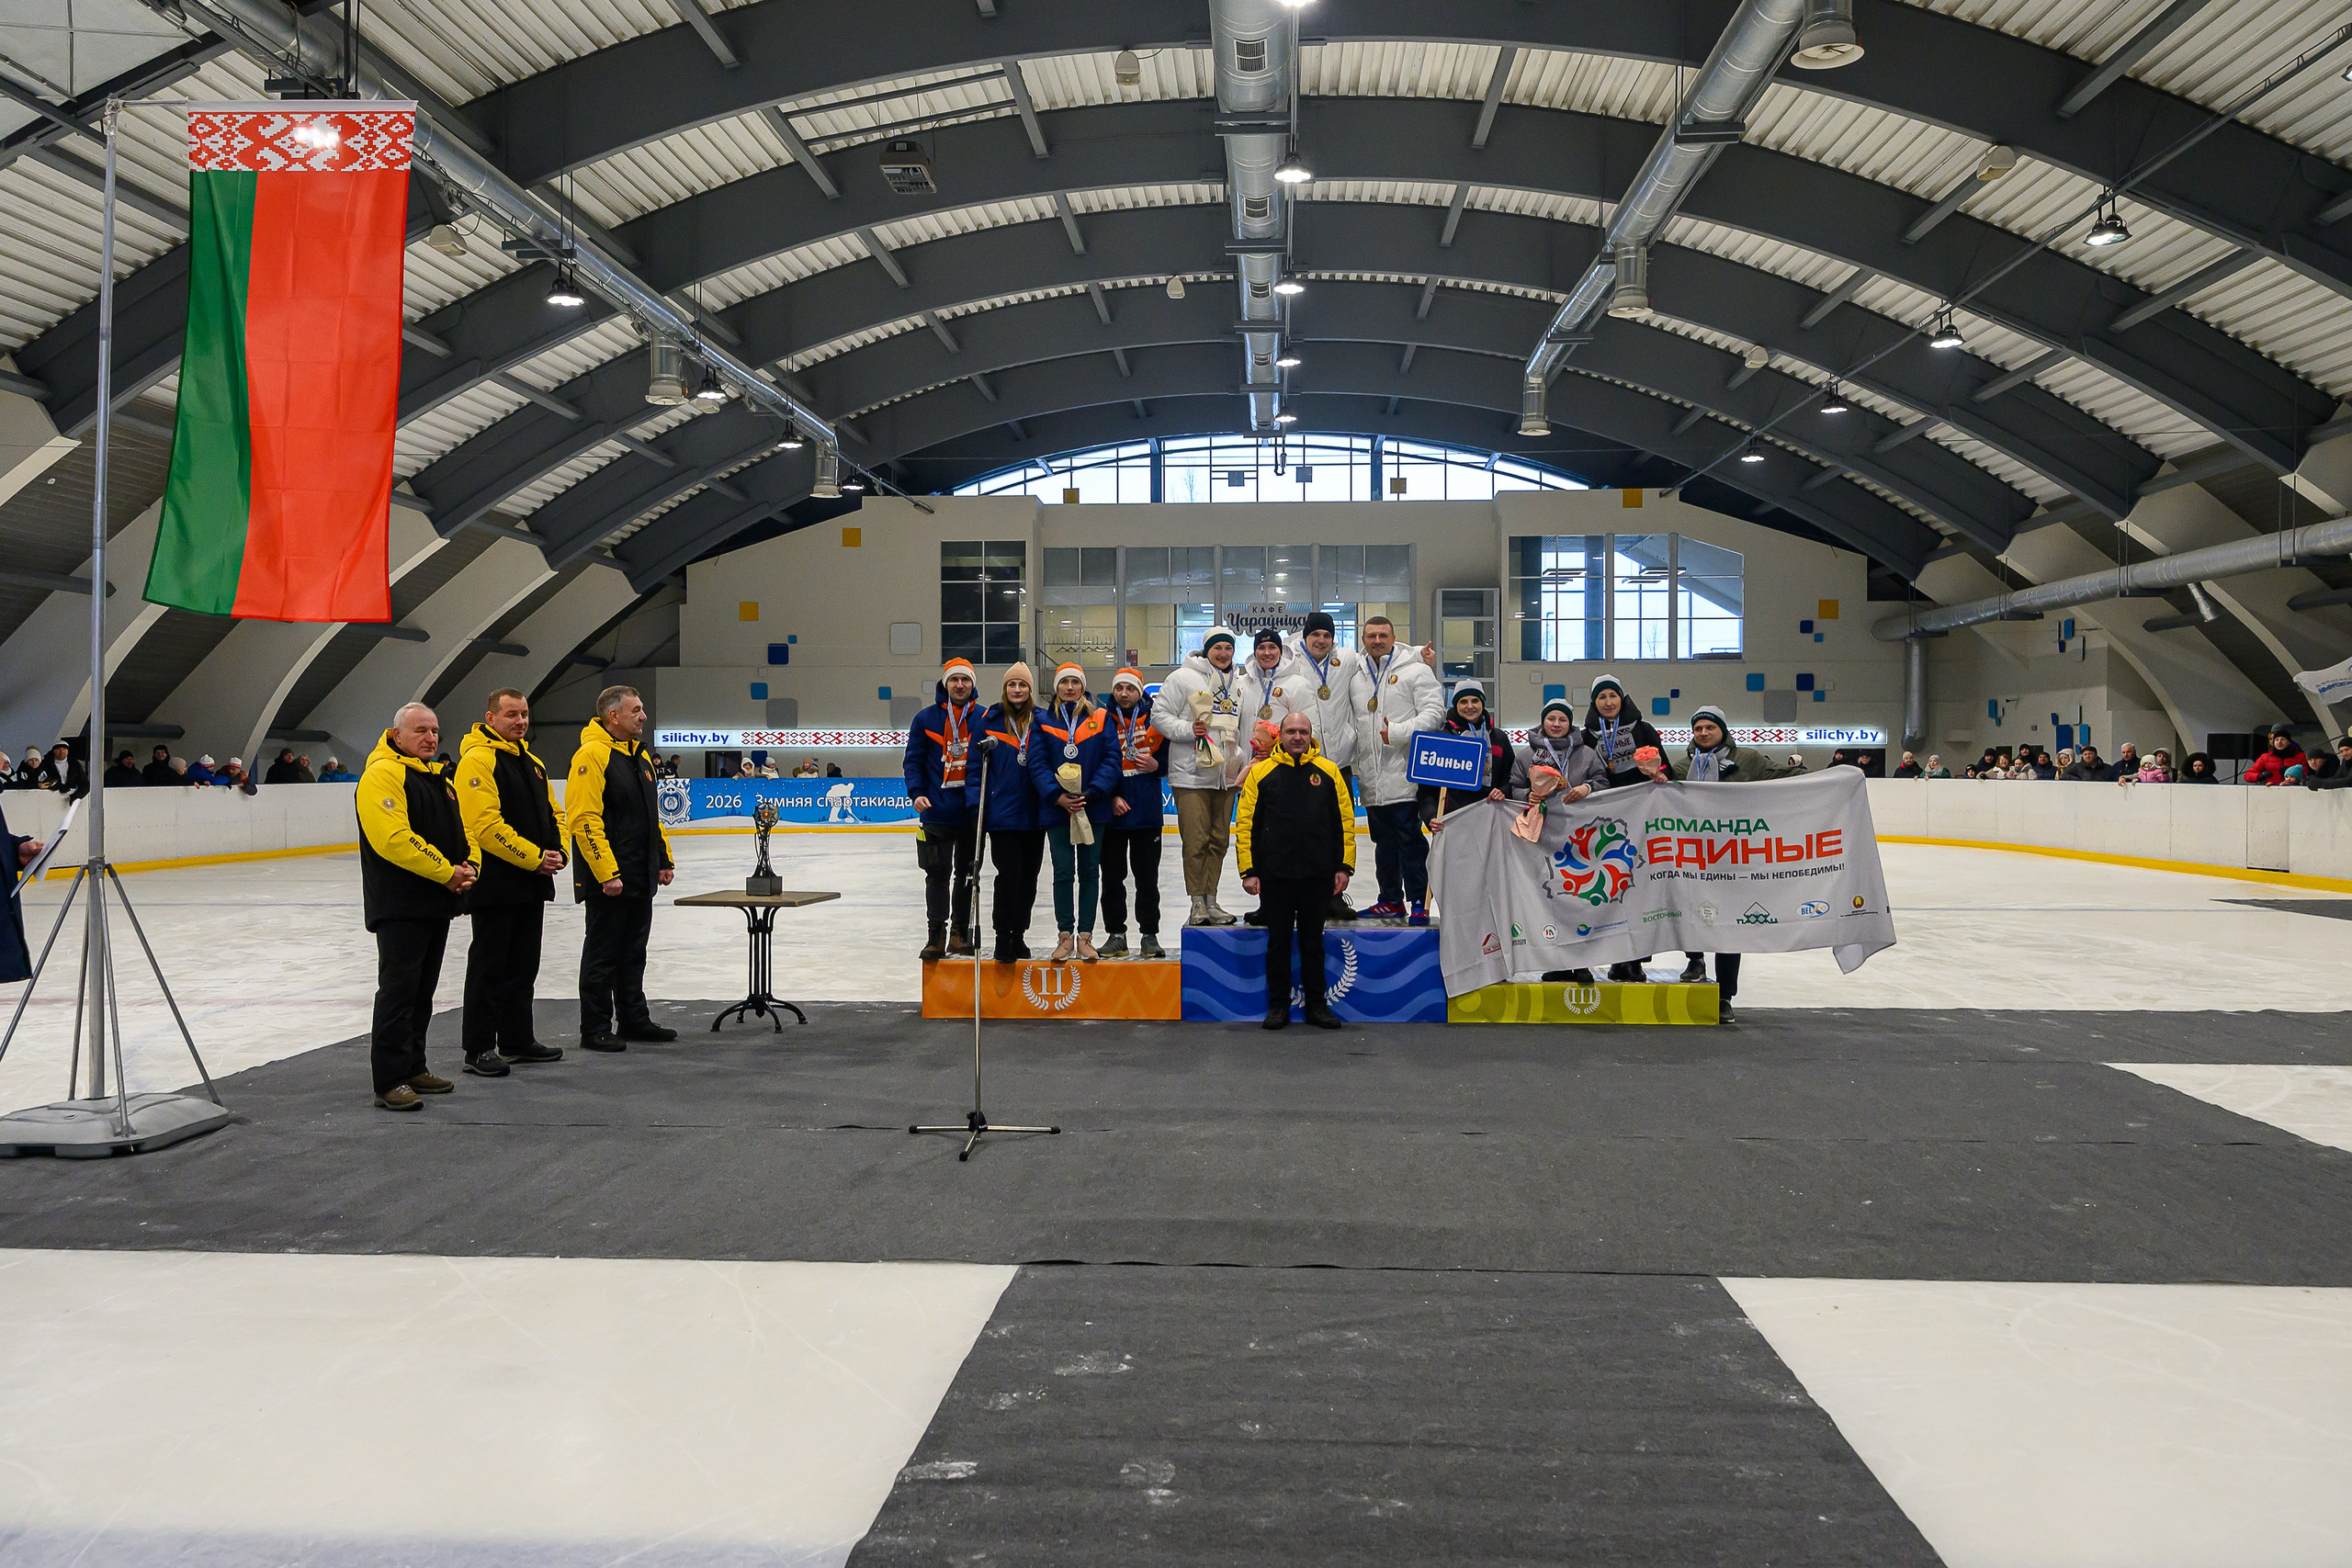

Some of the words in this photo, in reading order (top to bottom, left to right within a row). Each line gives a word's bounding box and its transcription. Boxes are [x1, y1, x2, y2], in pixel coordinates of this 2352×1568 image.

[662, 732, 729, 745] silichy.by
[1805, 729, 1879, 742] silichy.by
[1419, 750, 1473, 772] Единые
[706, 794, 742, 809] 2026
[755, 793, 812, 807] Зимняя
[816, 795, 913, 810] спартакиада
[1645, 817, 1770, 836] КОМАНДА
[408, 836, 443, 865] BELARUS
[493, 832, 527, 860] BELARUS
[582, 823, 602, 861] BELARUS
[1645, 829, 1843, 871] ЕДИНЫЕ
[1649, 870, 1680, 881] КОГДА
[1682, 871, 1698, 880] МЫ
[1700, 873, 1736, 882] ЕДИНЫ
[1750, 872, 1770, 881] МЫ
[1771, 863, 1845, 879] НЕПОБЕДИМЫ!
[1643, 910, 1682, 923] ВОСТОЧНЫЙ
[1037, 967, 1066, 996] II
[1570, 987, 1595, 1004] III
